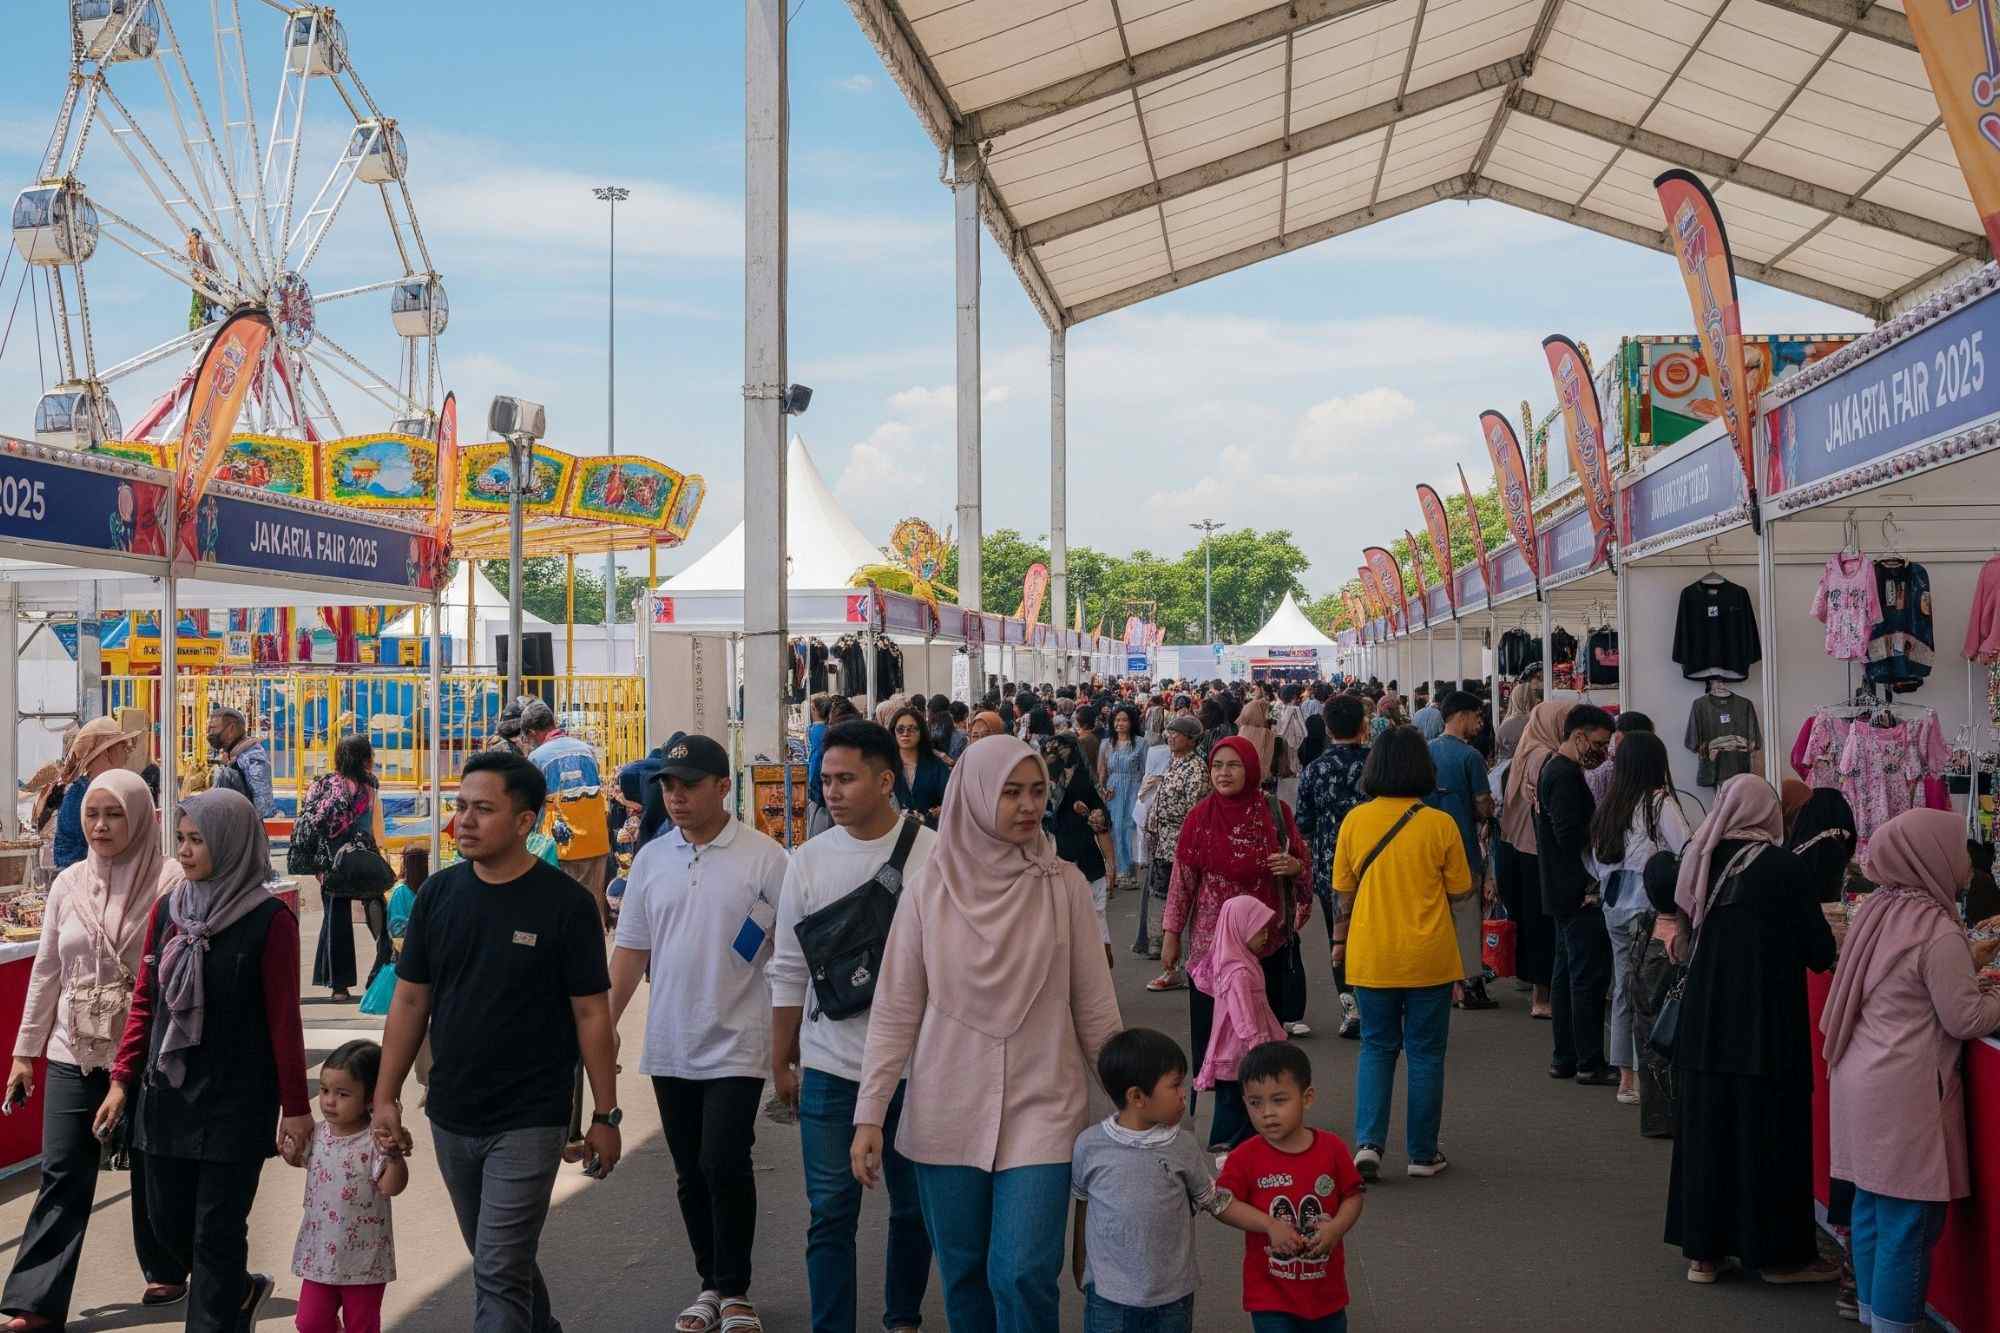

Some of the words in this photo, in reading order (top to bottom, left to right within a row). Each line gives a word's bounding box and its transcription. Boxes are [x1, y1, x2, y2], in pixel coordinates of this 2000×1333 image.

[1825, 380, 1891, 453] JAKARTA
[1892, 361, 1930, 425] FAIR
[1935, 330, 1985, 408] 2025
[0, 476, 46, 521] 025
[250, 520, 313, 560] JAKARTA
[316, 531, 346, 564] FAIR
[349, 536, 378, 568] 2025
